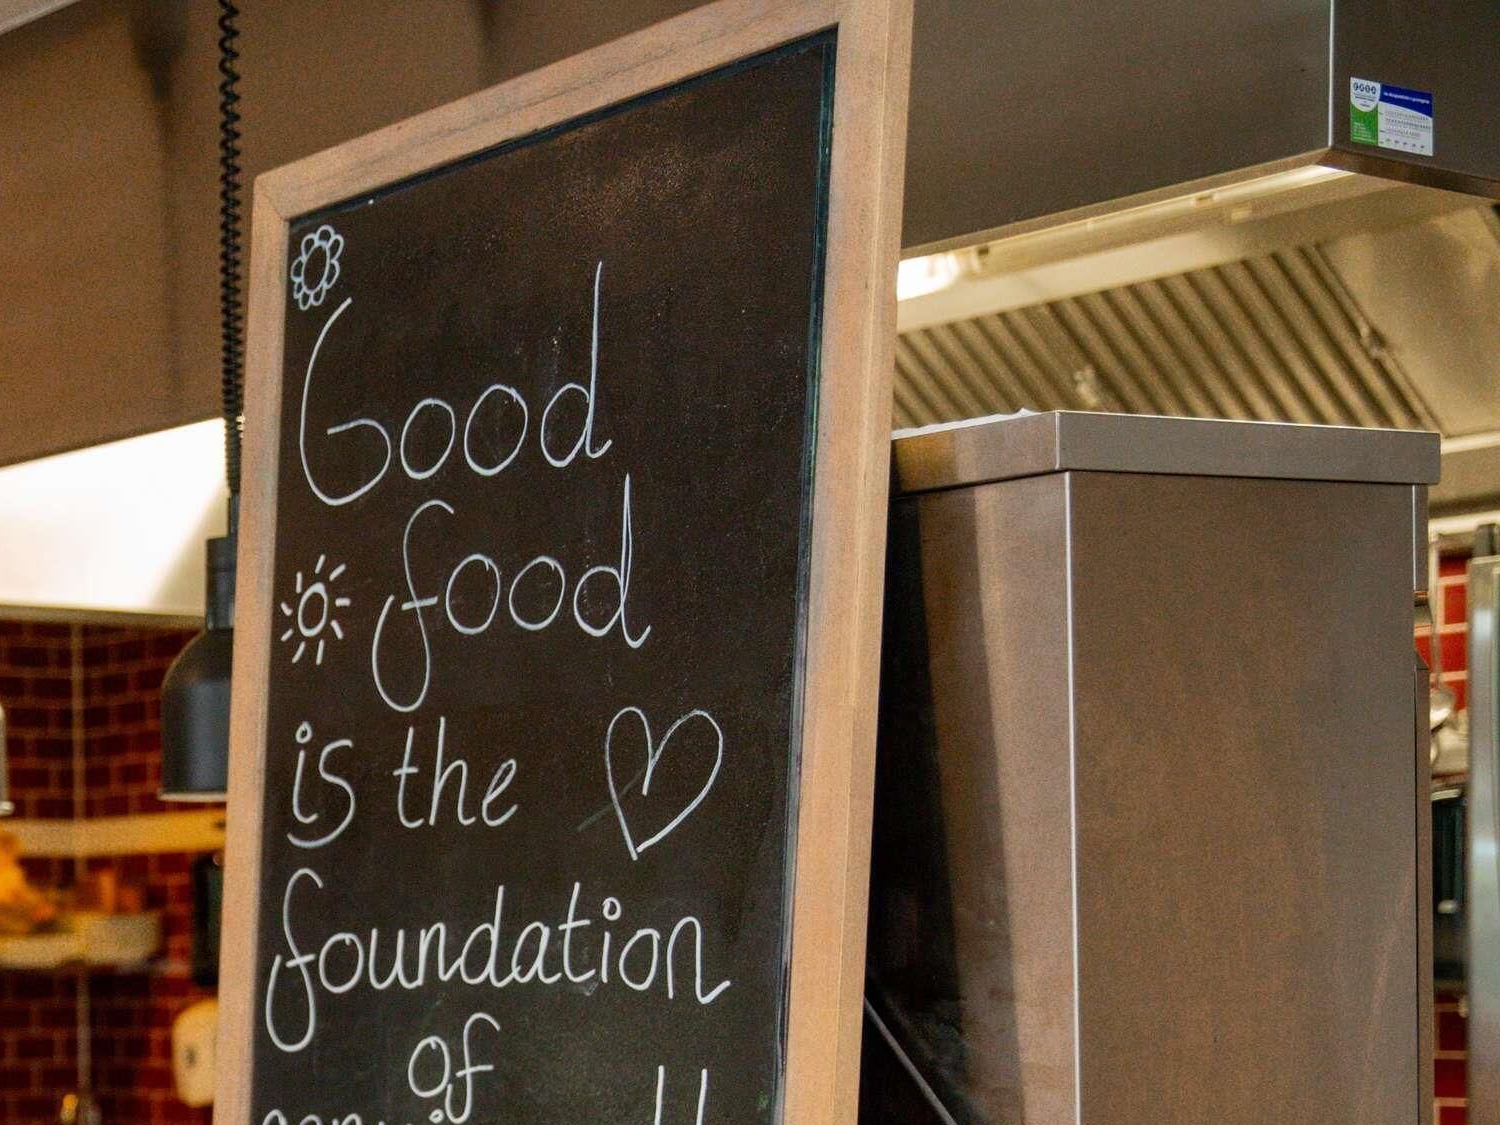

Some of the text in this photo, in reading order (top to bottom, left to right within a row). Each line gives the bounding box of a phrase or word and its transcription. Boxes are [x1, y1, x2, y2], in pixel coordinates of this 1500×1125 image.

[299, 258, 613, 506] Good
[372, 472, 651, 712] food
[286, 716, 518, 848] is the
[265, 867, 731, 1052] foundation
[407, 1011, 501, 1124] of
